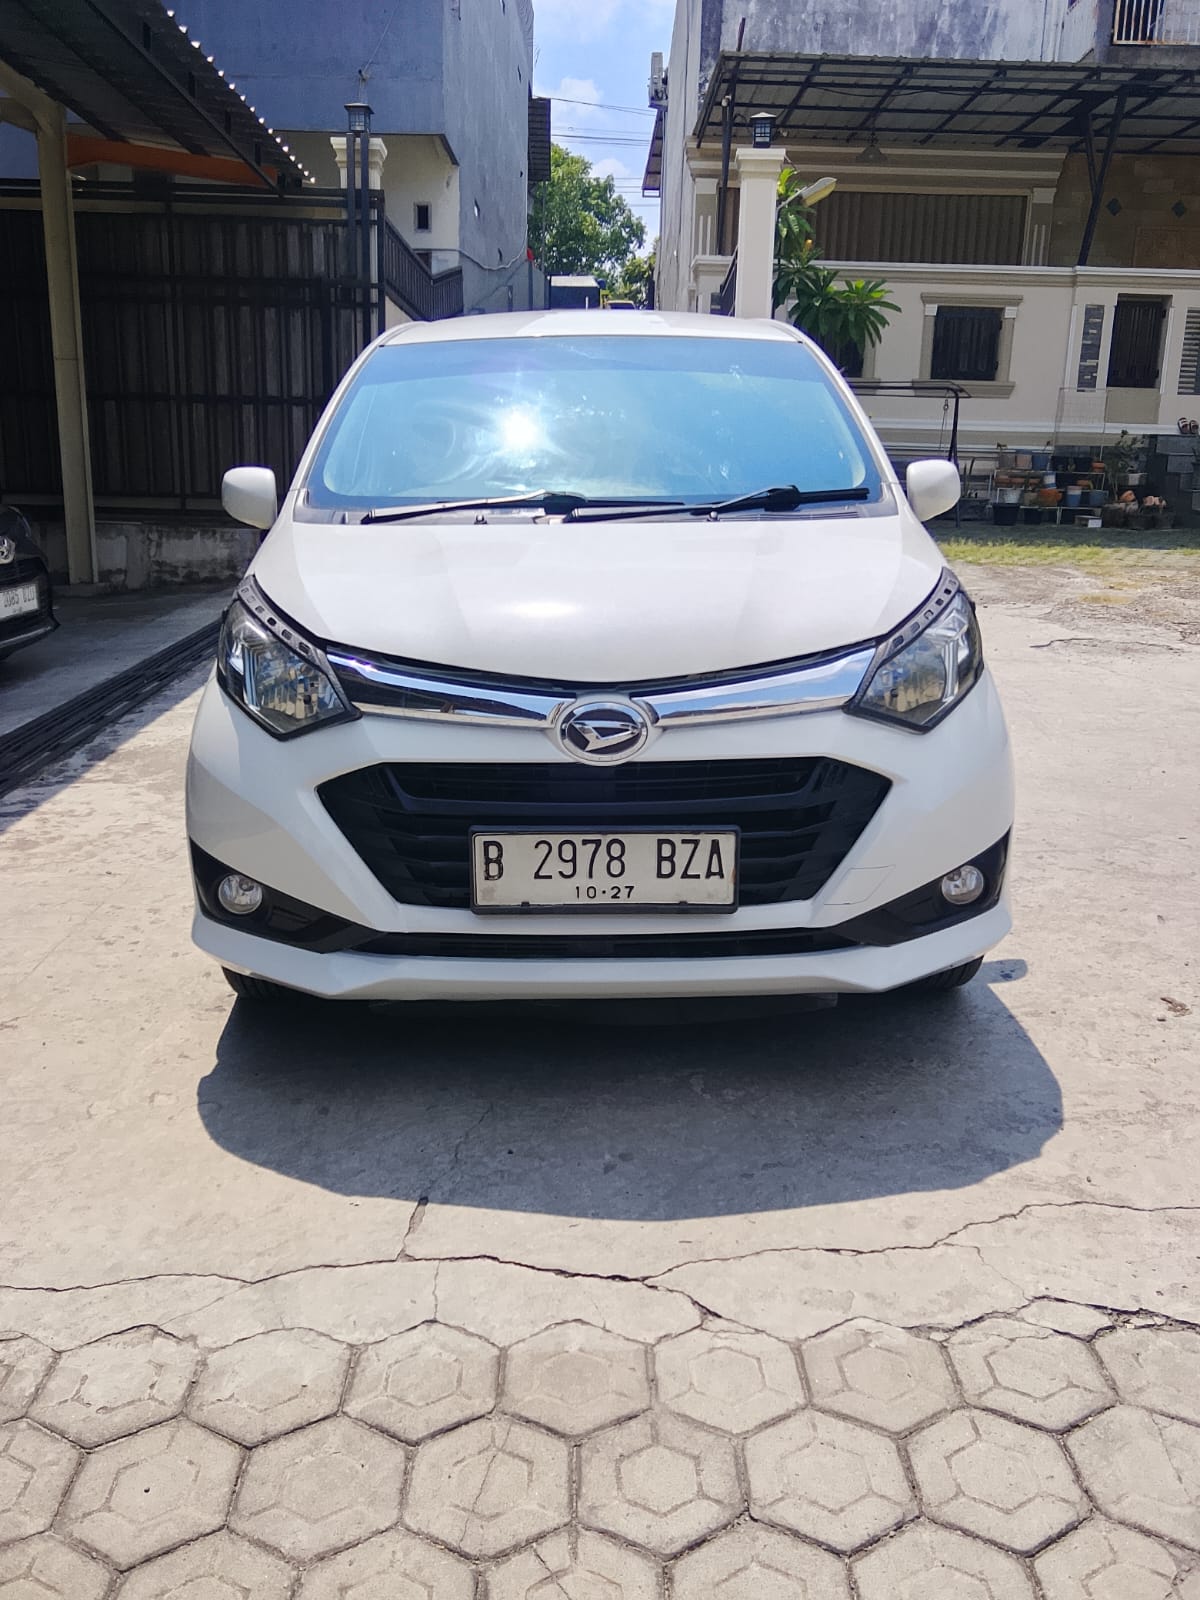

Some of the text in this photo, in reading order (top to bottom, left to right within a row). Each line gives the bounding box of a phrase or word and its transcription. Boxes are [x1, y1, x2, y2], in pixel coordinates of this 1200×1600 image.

[482, 838, 725, 881] B 2978 BZA
